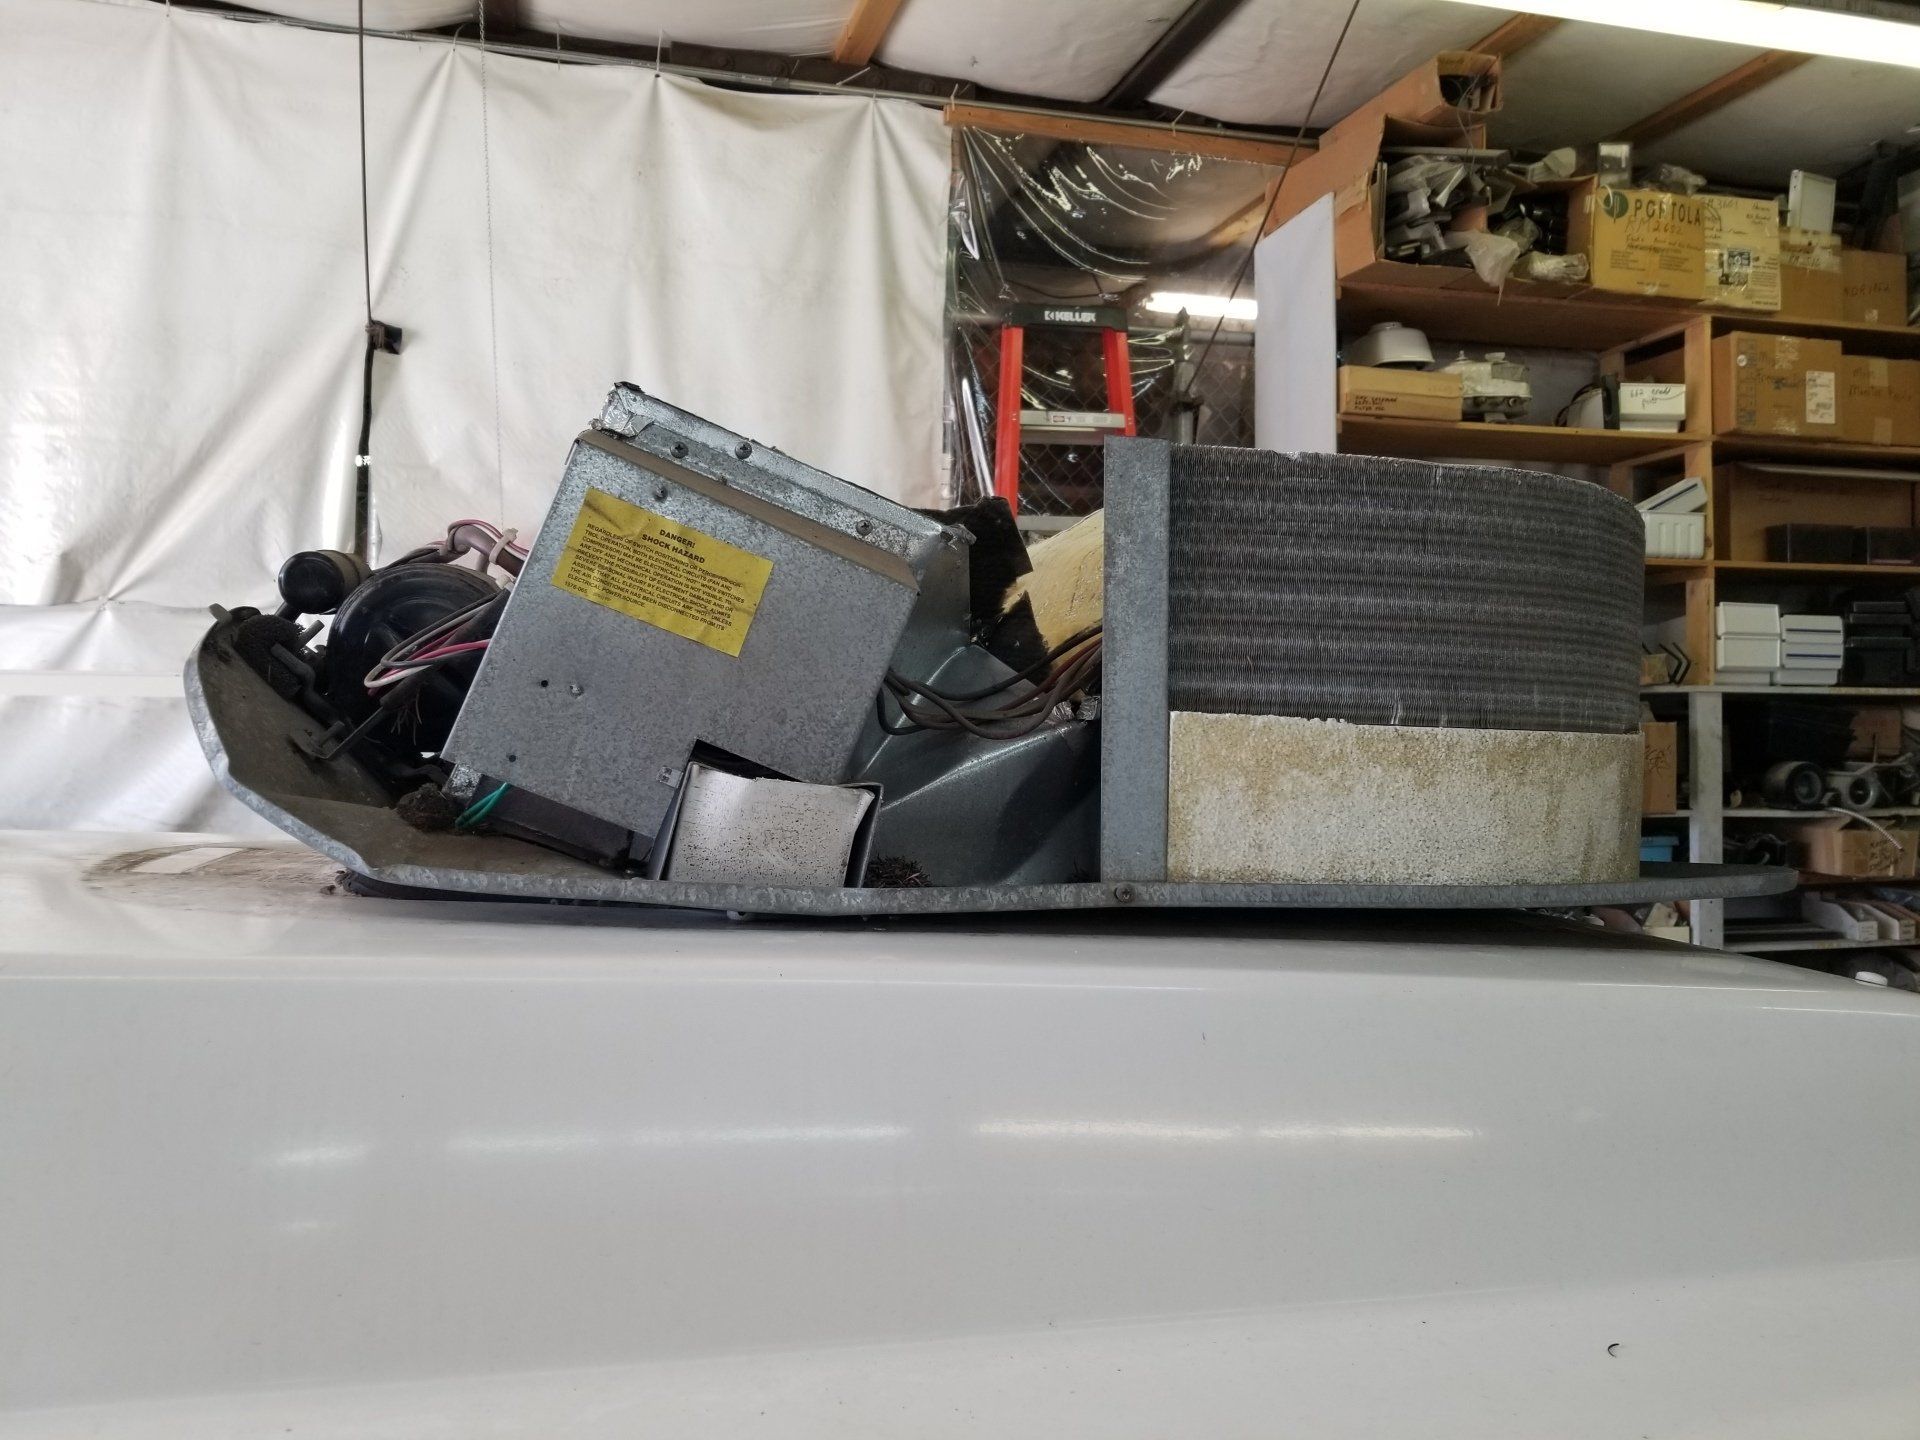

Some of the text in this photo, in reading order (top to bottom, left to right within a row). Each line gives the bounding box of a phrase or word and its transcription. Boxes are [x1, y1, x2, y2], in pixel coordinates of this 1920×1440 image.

[583, 529, 599, 539] TROL
[631, 548, 647, 558] BOTH
[647, 554, 681, 572] ELECTRICAL
[681, 568, 707, 582] CIRCUITS
[719, 583, 732, 592] AND
[586, 523, 624, 542] REGARDLESS
[632, 541, 654, 554] SWITCH
[653, 549, 689, 567] POSITIONING
[640, 533, 705, 564] SHOCK HAZARD
[658, 528, 696, 549] DANGER!
[567, 573, 601, 590] ELECTRICAL
[601, 586, 622, 598] POWER
[572, 560, 595, 573] ASSUME
[595, 569, 610, 579] THAT
[610, 575, 621, 583] ALL
[621, 579, 655, 597] ELECTRICAL
[655, 593, 681, 607] CIRCUITS
[680, 603, 693, 611] ARE
[710, 614, 732, 627] UNLESS
[574, 554, 596, 566] SEVERE
[626, 574, 646, 586] INJURY
[655, 585, 689, 603] ELECTRICAL
[709, 607, 731, 619] ALWAYS
[576, 548, 603, 562] PREVENT
[603, 558, 614, 566] THE
[614, 562, 648, 580] POSSIBILITY
[656, 579, 688, 595] EQUIPMENT
[688, 591, 712, 605] DAMAGE
[579, 541, 591, 550] ARE
[591, 546, 603, 555] OFF
[603, 551, 616, 560] AND
[616, 556, 652, 574] MECHANICAL
[652, 570, 683, 586] OPERATION
[689, 585, 701, 593] NOT
[622, 551, 634, 560] MAY
[642, 559, 682, 579] ELECTRICALLY
[699, 582, 716, 592] WHEN
[716, 588, 745, 604] SWITCHES
[569, 566, 725, 631] THE AIR CONDITIONER HAS BEEN DISCONNECTED FROM ITS
